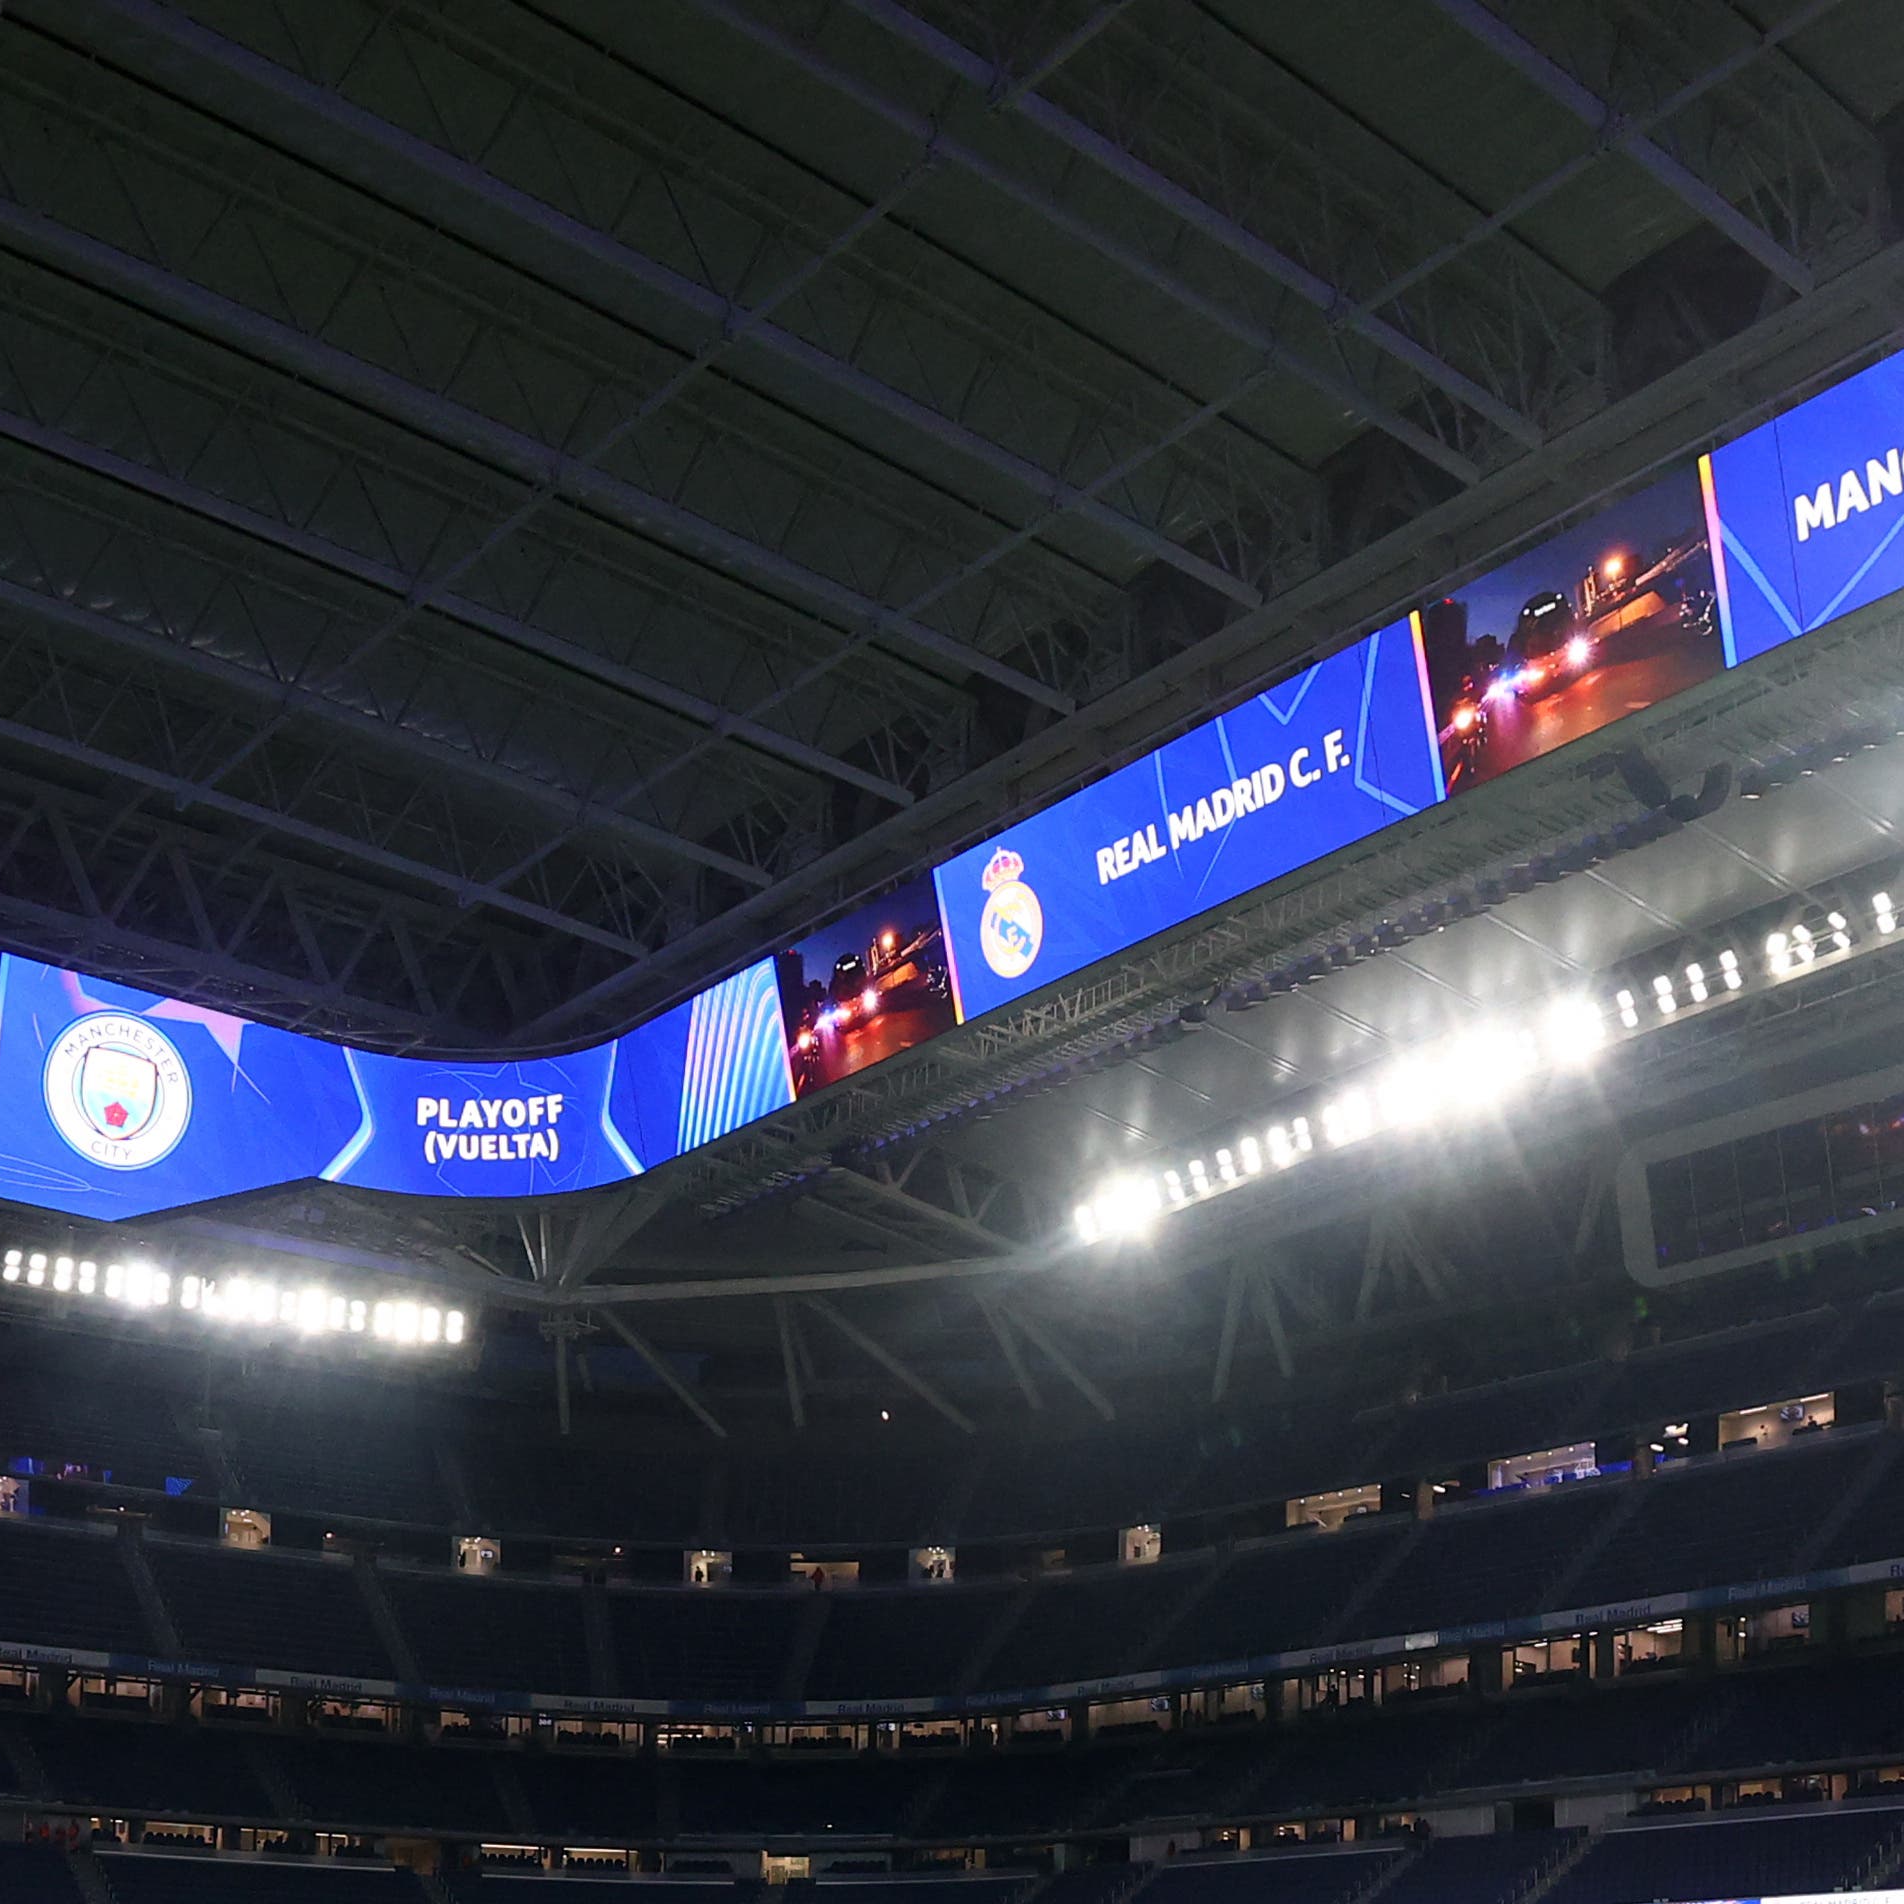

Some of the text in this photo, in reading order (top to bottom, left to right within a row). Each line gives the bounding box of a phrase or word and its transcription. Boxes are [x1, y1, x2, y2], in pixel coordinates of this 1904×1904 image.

[1096, 727, 1352, 885] REAL MADRID C. F.
[64, 1022, 179, 1085] MANCHESTER
[416, 1093, 563, 1131] PLAYOFF
[90, 1139, 133, 1161] CITY
[424, 1124, 559, 1164] (VUELTA)
[1576, 1604, 1651, 1625] Real Madrid
[27, 1648, 72, 1665] Madrid
[564, 1700, 634, 1713] Real Madrid
[838, 1702, 904, 1715] Real Madrid
